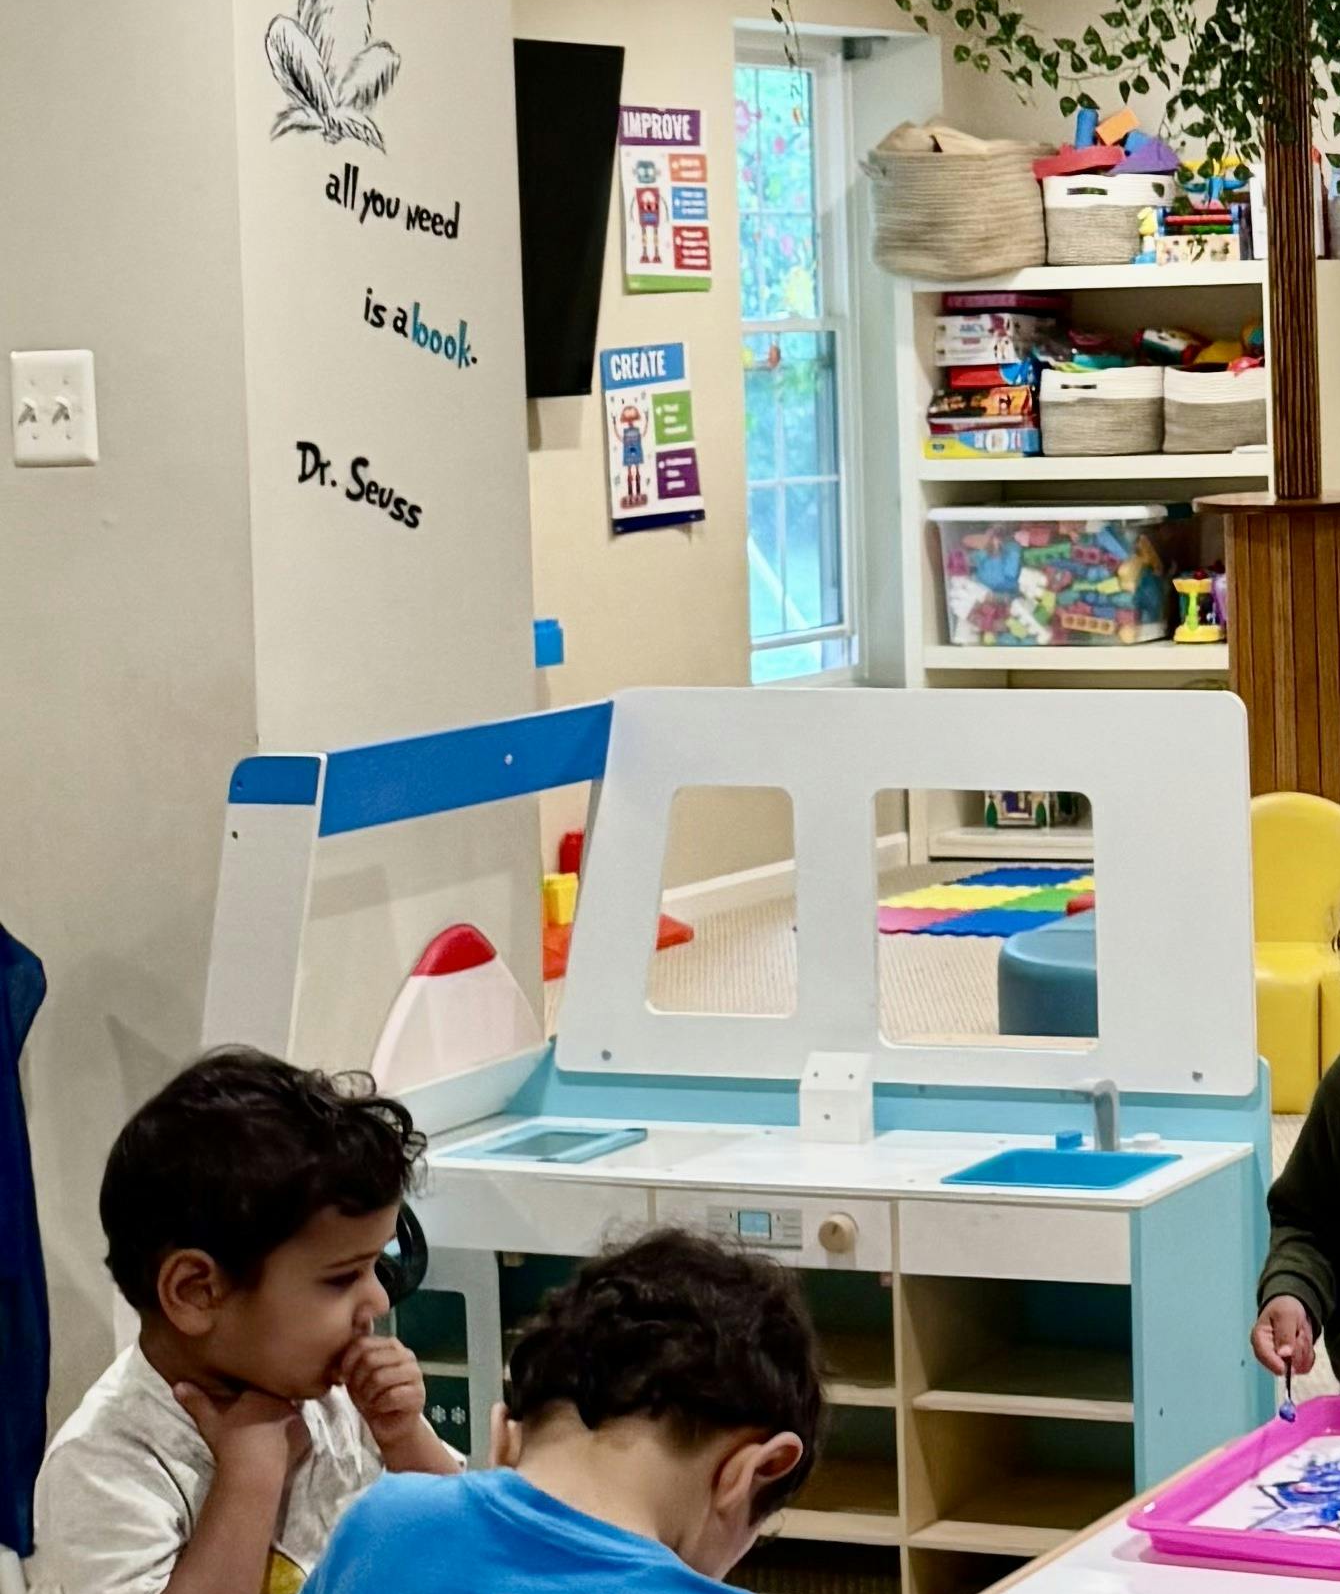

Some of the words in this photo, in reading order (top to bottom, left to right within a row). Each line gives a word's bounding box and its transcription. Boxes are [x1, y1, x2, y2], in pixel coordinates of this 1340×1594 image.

[622, 111, 693, 141] IMPROVE
[325, 163, 359, 210] all
[359, 188, 400, 224] you
[363, 287, 387, 329] is
[393, 306, 409, 338] a
[411, 301, 478, 369] book.
[610, 350, 667, 381] CREATE
[296, 440, 338, 488] Dr.
[345, 455, 423, 529] Seuss
